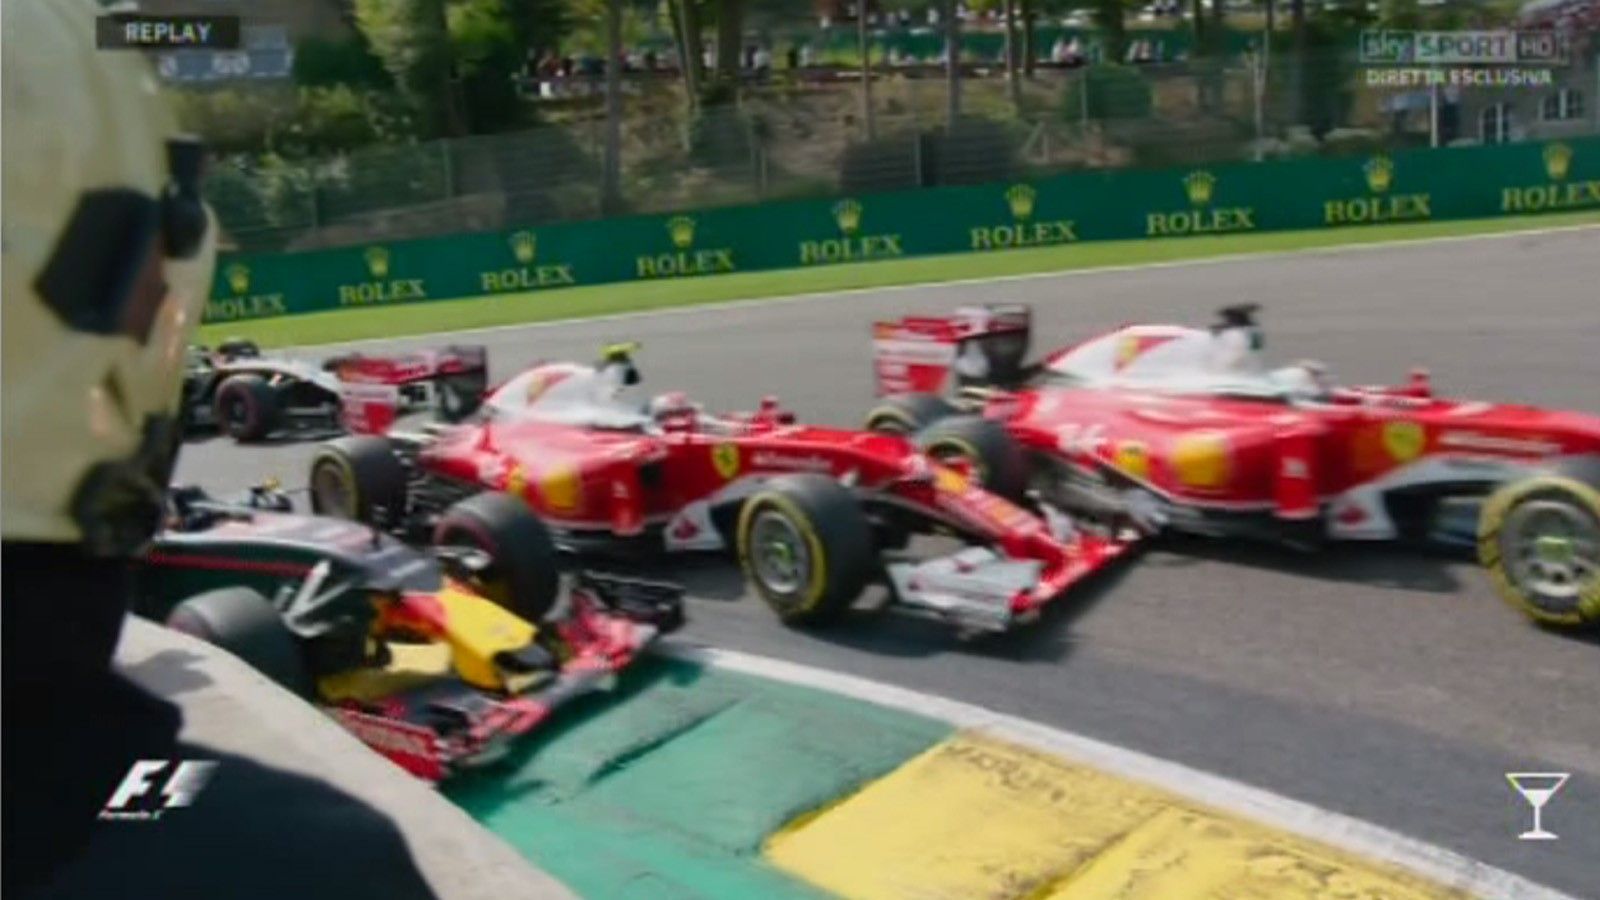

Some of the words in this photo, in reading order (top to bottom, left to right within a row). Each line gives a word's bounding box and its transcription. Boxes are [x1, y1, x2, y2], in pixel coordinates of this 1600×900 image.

[1146, 207, 1255, 235] ROLEX
[1324, 193, 1431, 223] ROLEX
[800, 234, 904, 263] ROLEX
[971, 220, 1077, 250] ROLEX
[480, 264, 574, 291] ROLEX
[636, 249, 735, 278] ROLEX
[339, 279, 427, 305] ROLEX
[206, 293, 286, 320] ROLEX
